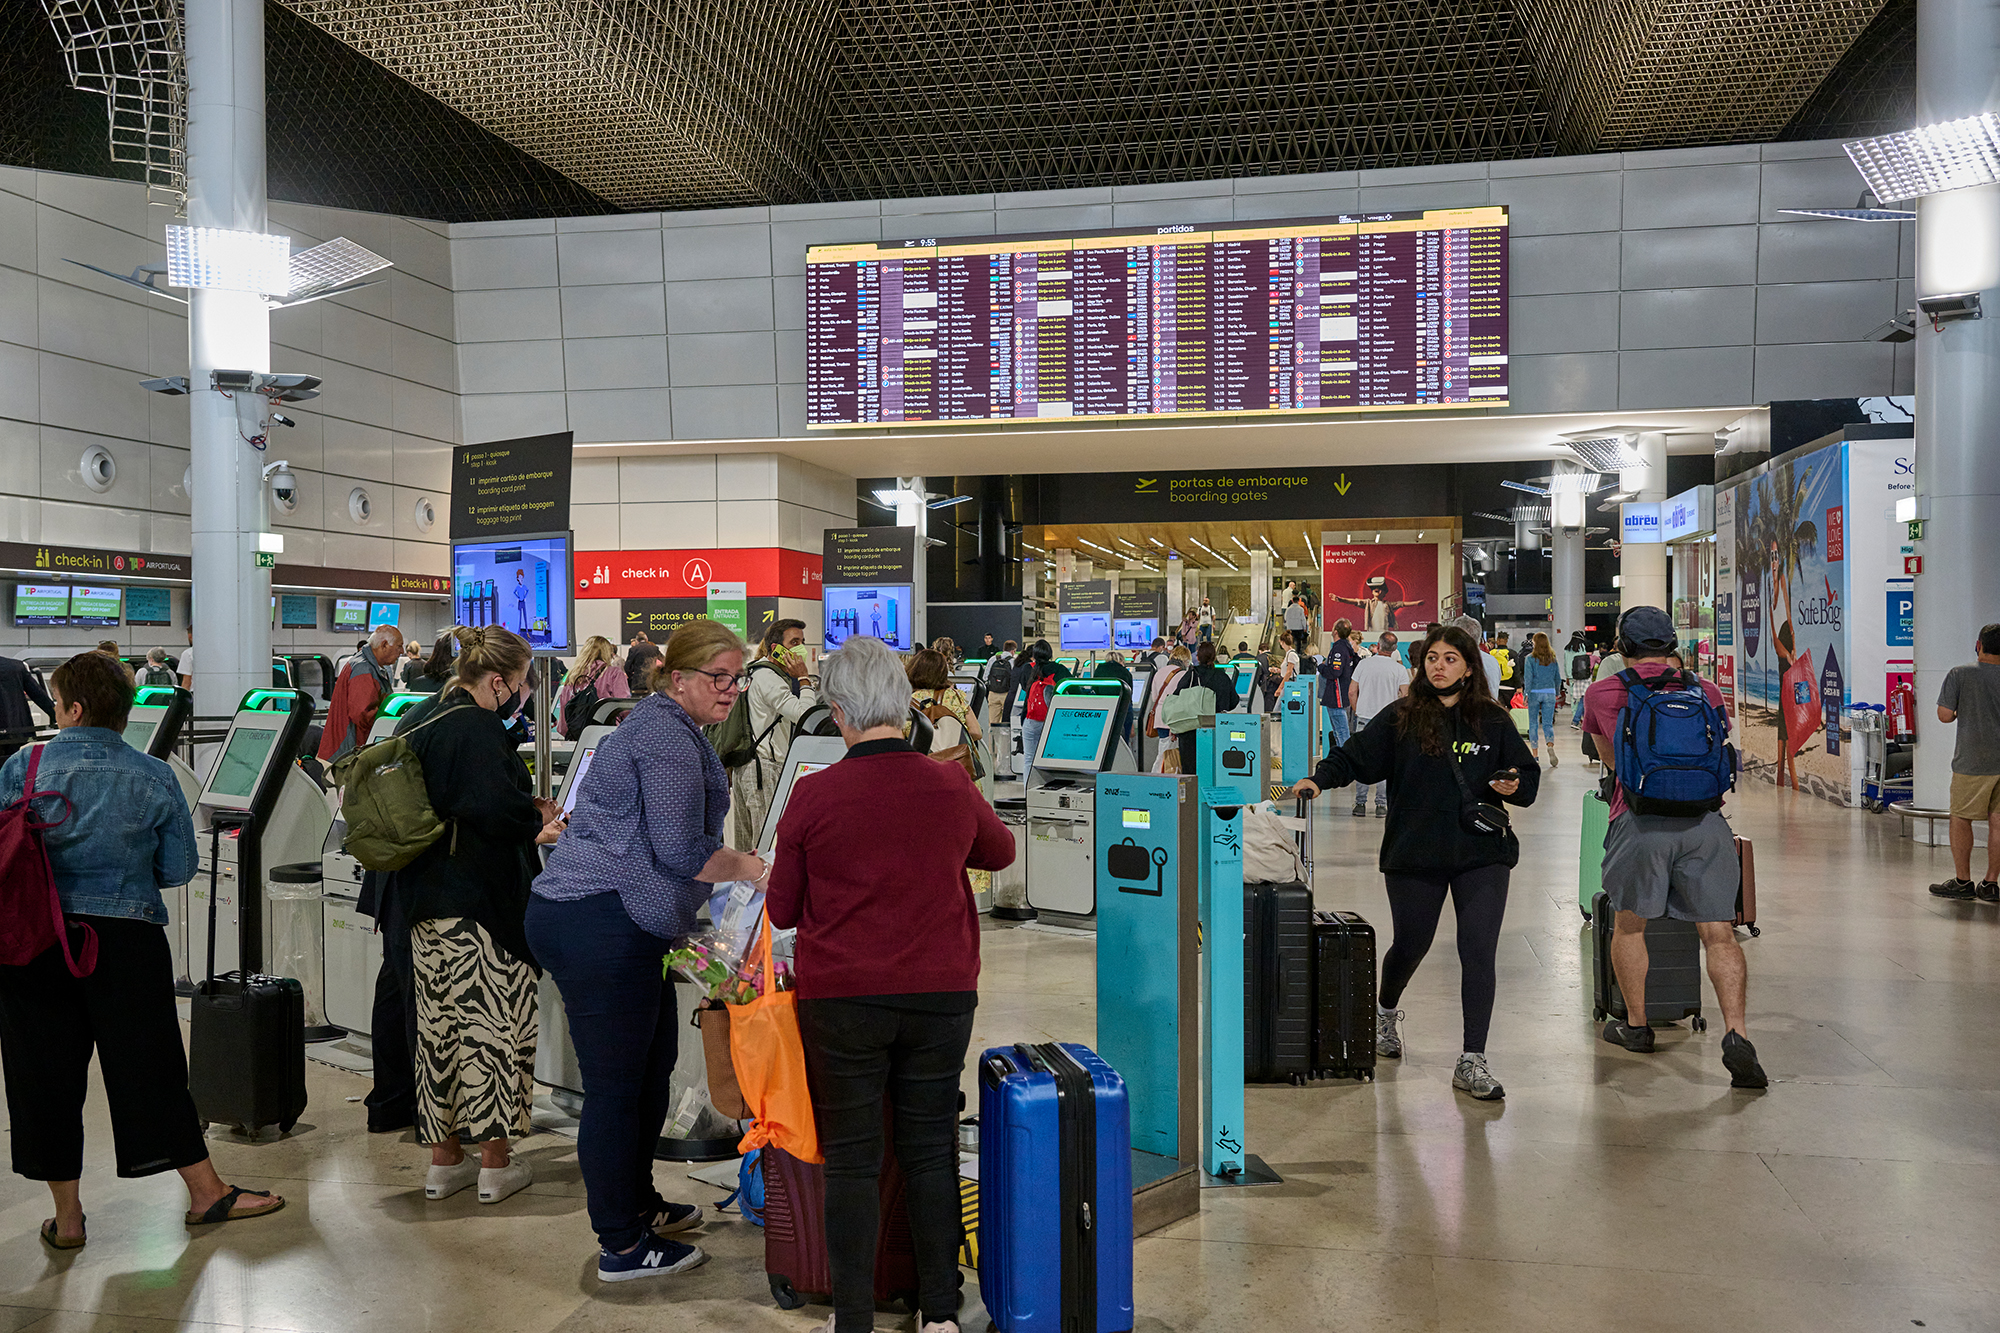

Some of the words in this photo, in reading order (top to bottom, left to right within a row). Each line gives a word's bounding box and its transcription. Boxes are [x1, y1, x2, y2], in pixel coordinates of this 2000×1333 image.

[478, 476, 500, 485] imprimir
[500, 474, 517, 483] cartão
[526, 470, 554, 480] embarque
[1170, 477, 1213, 491] portas
[1217, 476, 1234, 487] de
[1238, 475, 1309, 489] embarque
[514, 484, 526, 493] print
[1170, 491, 1227, 504] boarding
[1232, 491, 1268, 504] gates
[477, 505, 498, 514] imprimir
[499, 503, 520, 513] etiqueta
[529, 501, 555, 511] bagagem
[476, 517, 499, 526] baggage
[500, 516, 509, 524] tag
[510, 514, 522, 523] print
[1625, 515, 1658, 526] abreu
[1828, 511, 1836, 526] WE
[1828, 526, 1841, 544] LOVE
[1342, 549, 1366, 558] believe,
[1828, 542, 1842, 558] BAGS
[55, 553, 102, 568] check-in
[129, 557, 145, 571] TAP
[1348, 556, 1357, 565] fly
[622, 567, 656, 578] check
[659, 568, 669, 578] in
[690, 564, 705, 582] A
[401, 580, 427, 589] check-in
[344, 611, 357, 620] A15
[650, 613, 680, 622] portas
[682, 612, 694, 620] de
[651, 1212, 670, 1226] N
[642, 1250, 664, 1267] N
